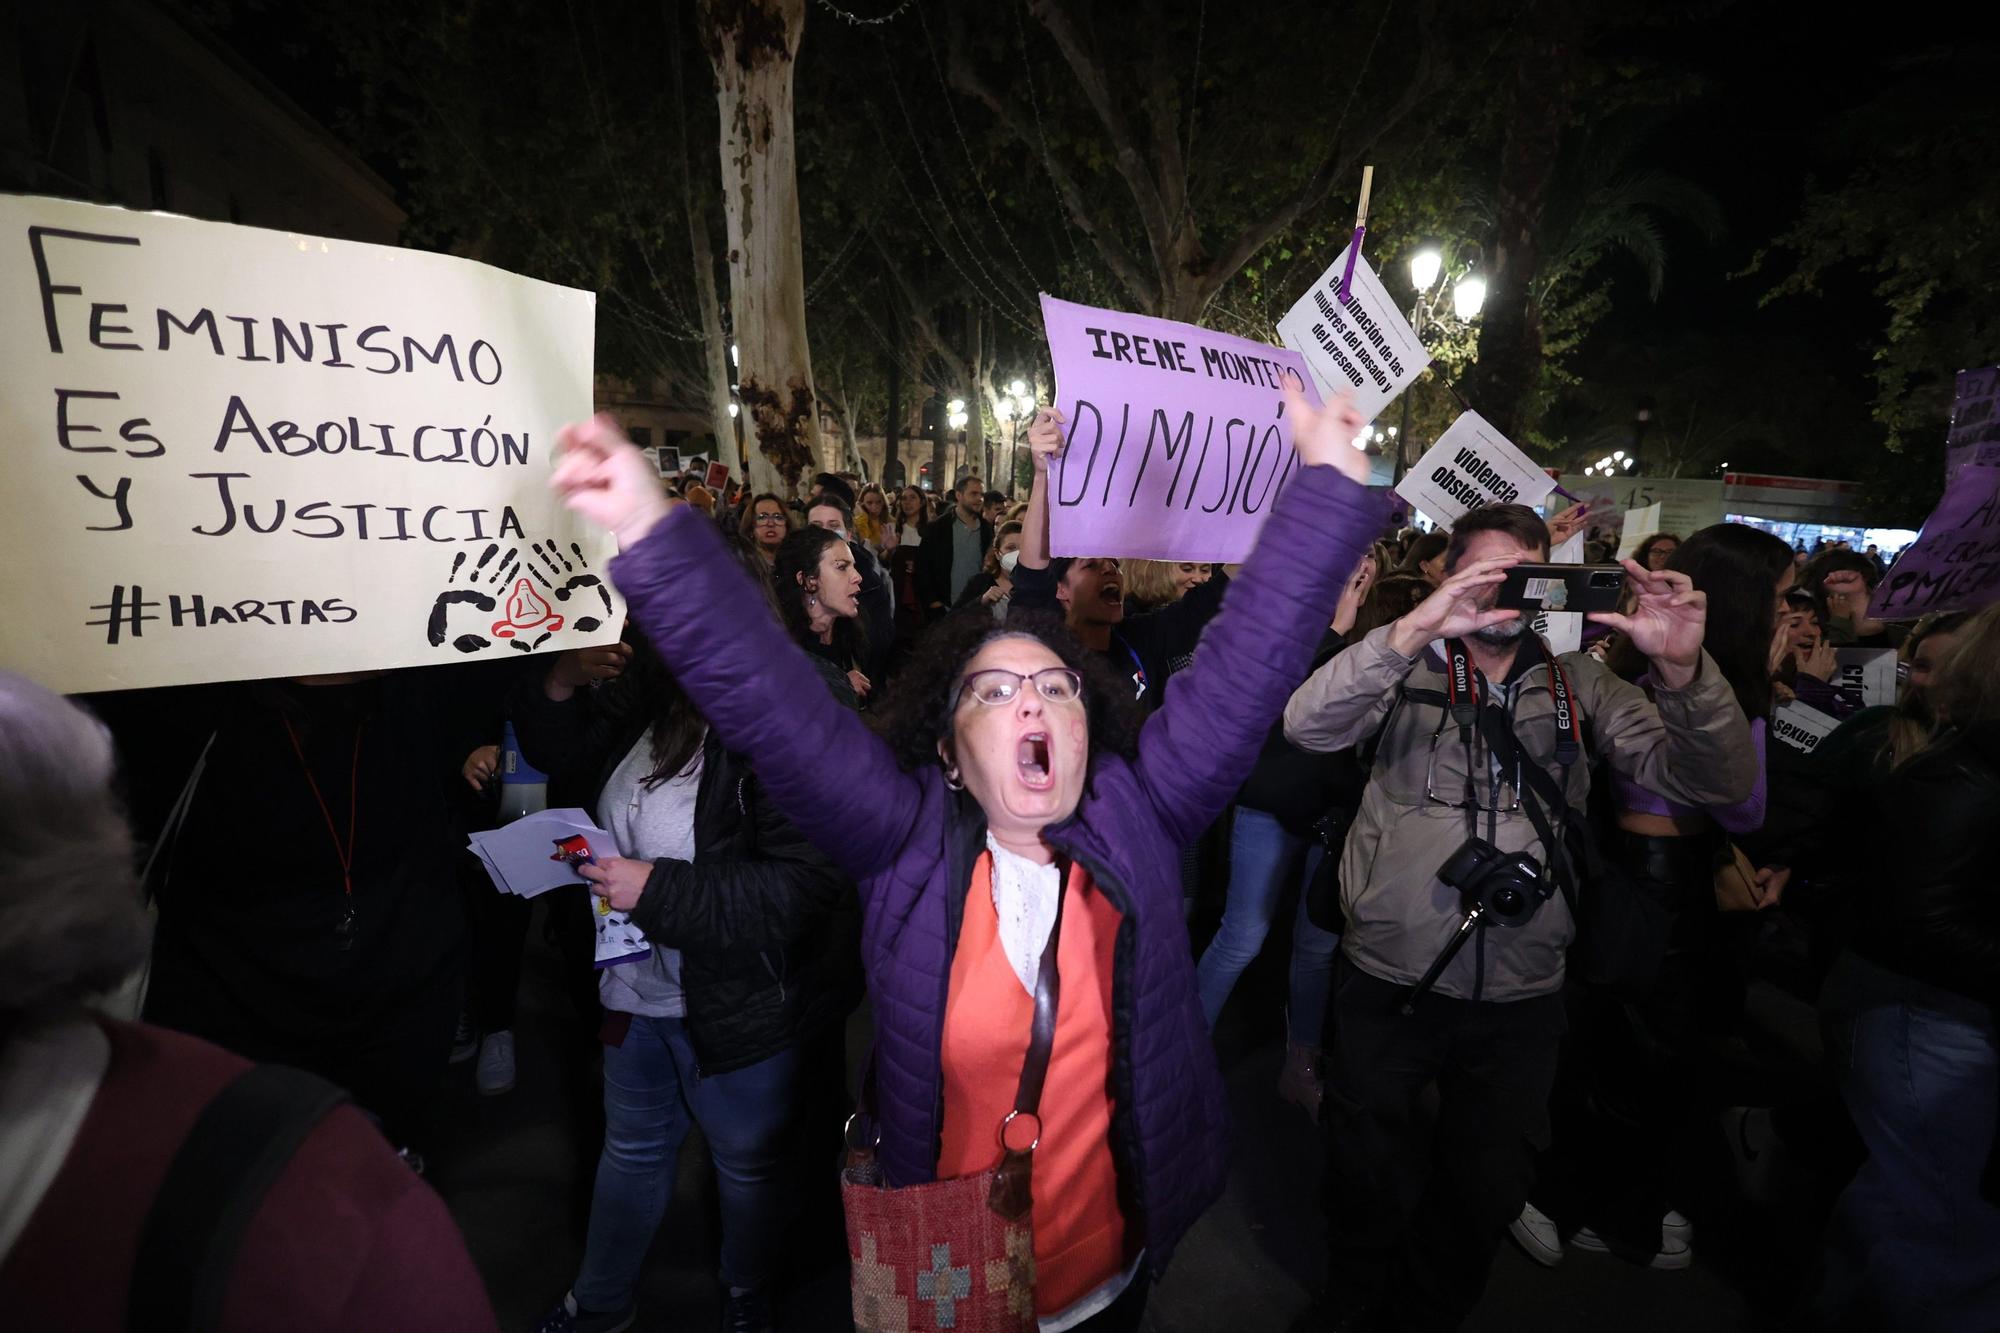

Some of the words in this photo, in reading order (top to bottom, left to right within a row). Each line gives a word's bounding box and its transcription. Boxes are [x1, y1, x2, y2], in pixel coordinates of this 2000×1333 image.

[28, 225, 502, 385] FEMINISMO
[1085, 327, 1196, 374] IRENE
[1312, 323, 1331, 344] del
[1322, 339, 1364, 388] presente
[1313, 289, 1348, 336] mujeres
[1342, 330, 1362, 352] del
[1355, 347, 1388, 388] pasado
[1381, 383, 1393, 395] y
[1379, 344, 1395, 362] de
[1388, 356, 1405, 378] las
[214, 396, 529, 467] ABOLICIÓN
[1431, 466, 1486, 511] obstétr
[1453, 447, 1519, 503] violencia
[189, 472, 525, 542] JUSTICIA
[85, 584, 357, 645] #HARTAS
[1454, 653, 1467, 693] Canon
[1555, 682, 1566, 698] 6D
[1842, 664, 1869, 690] crí
[1557, 699, 1570, 730] EOS
[1518, 863, 1537, 878] Canon
